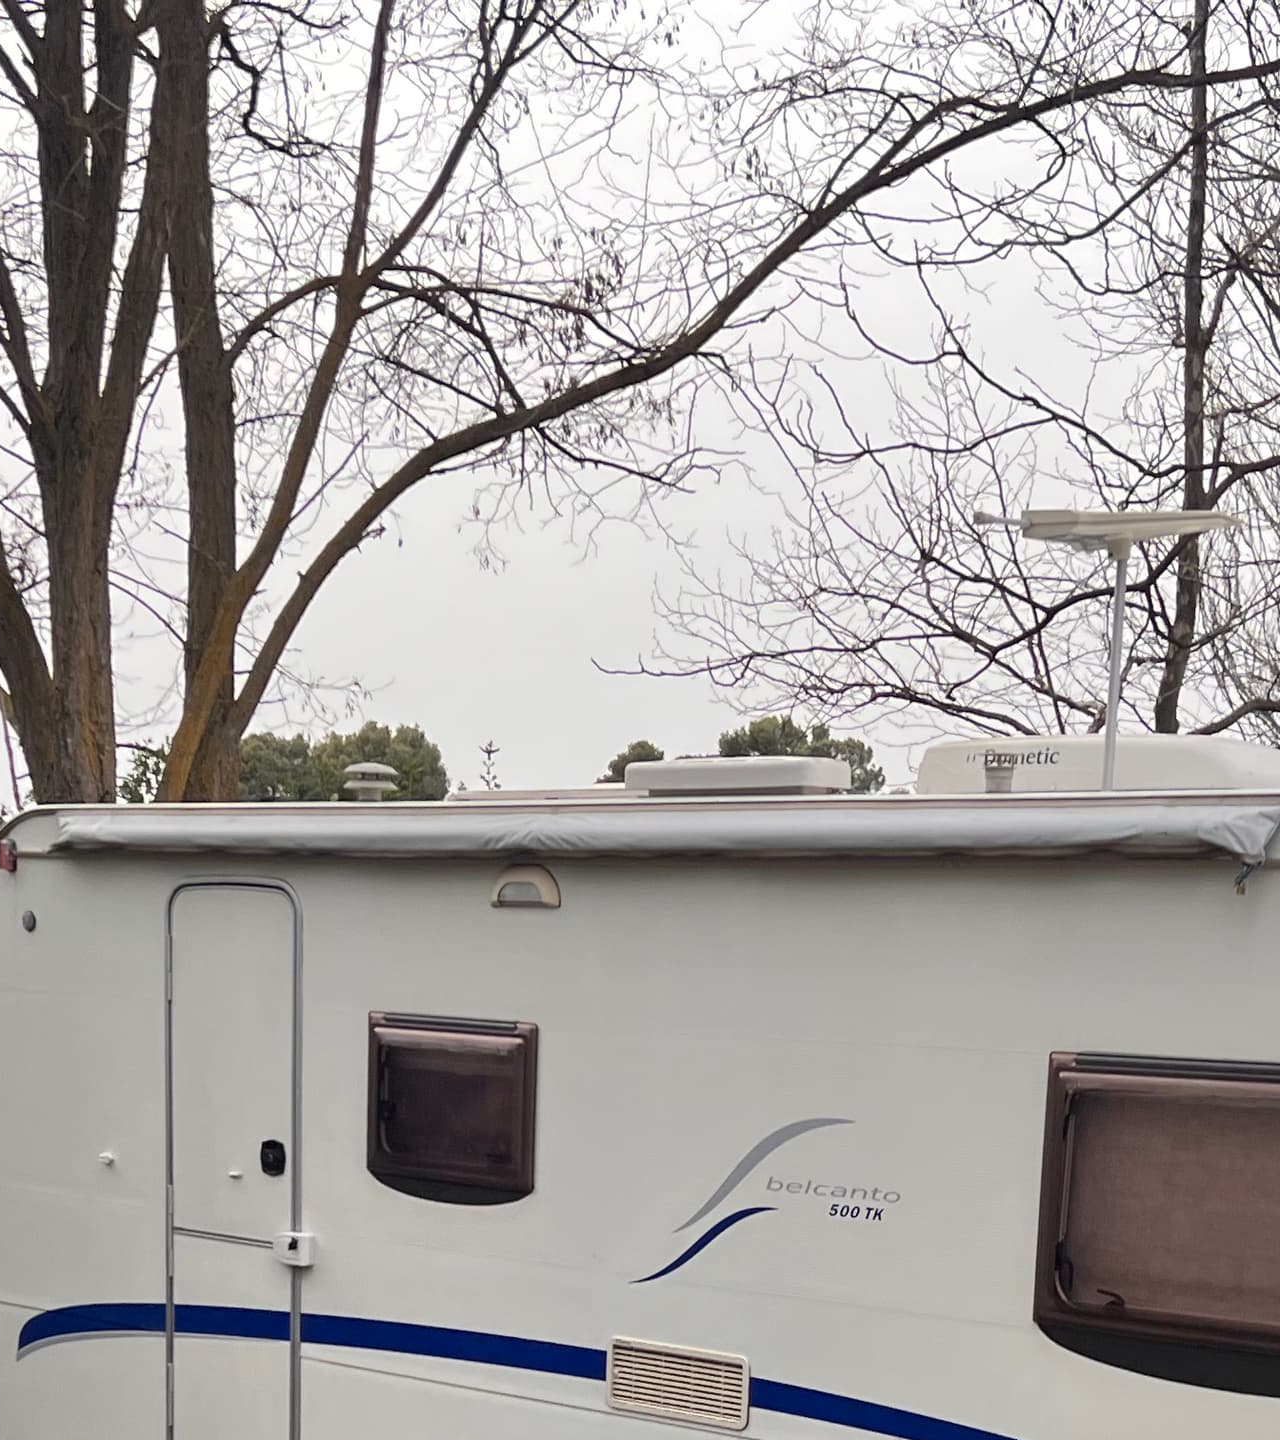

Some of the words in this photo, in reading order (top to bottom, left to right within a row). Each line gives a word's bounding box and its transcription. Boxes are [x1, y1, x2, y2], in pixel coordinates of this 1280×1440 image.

[766, 1176, 901, 1204] belcanto
[828, 1203, 860, 1218] 500
[865, 1206, 884, 1221] TK
